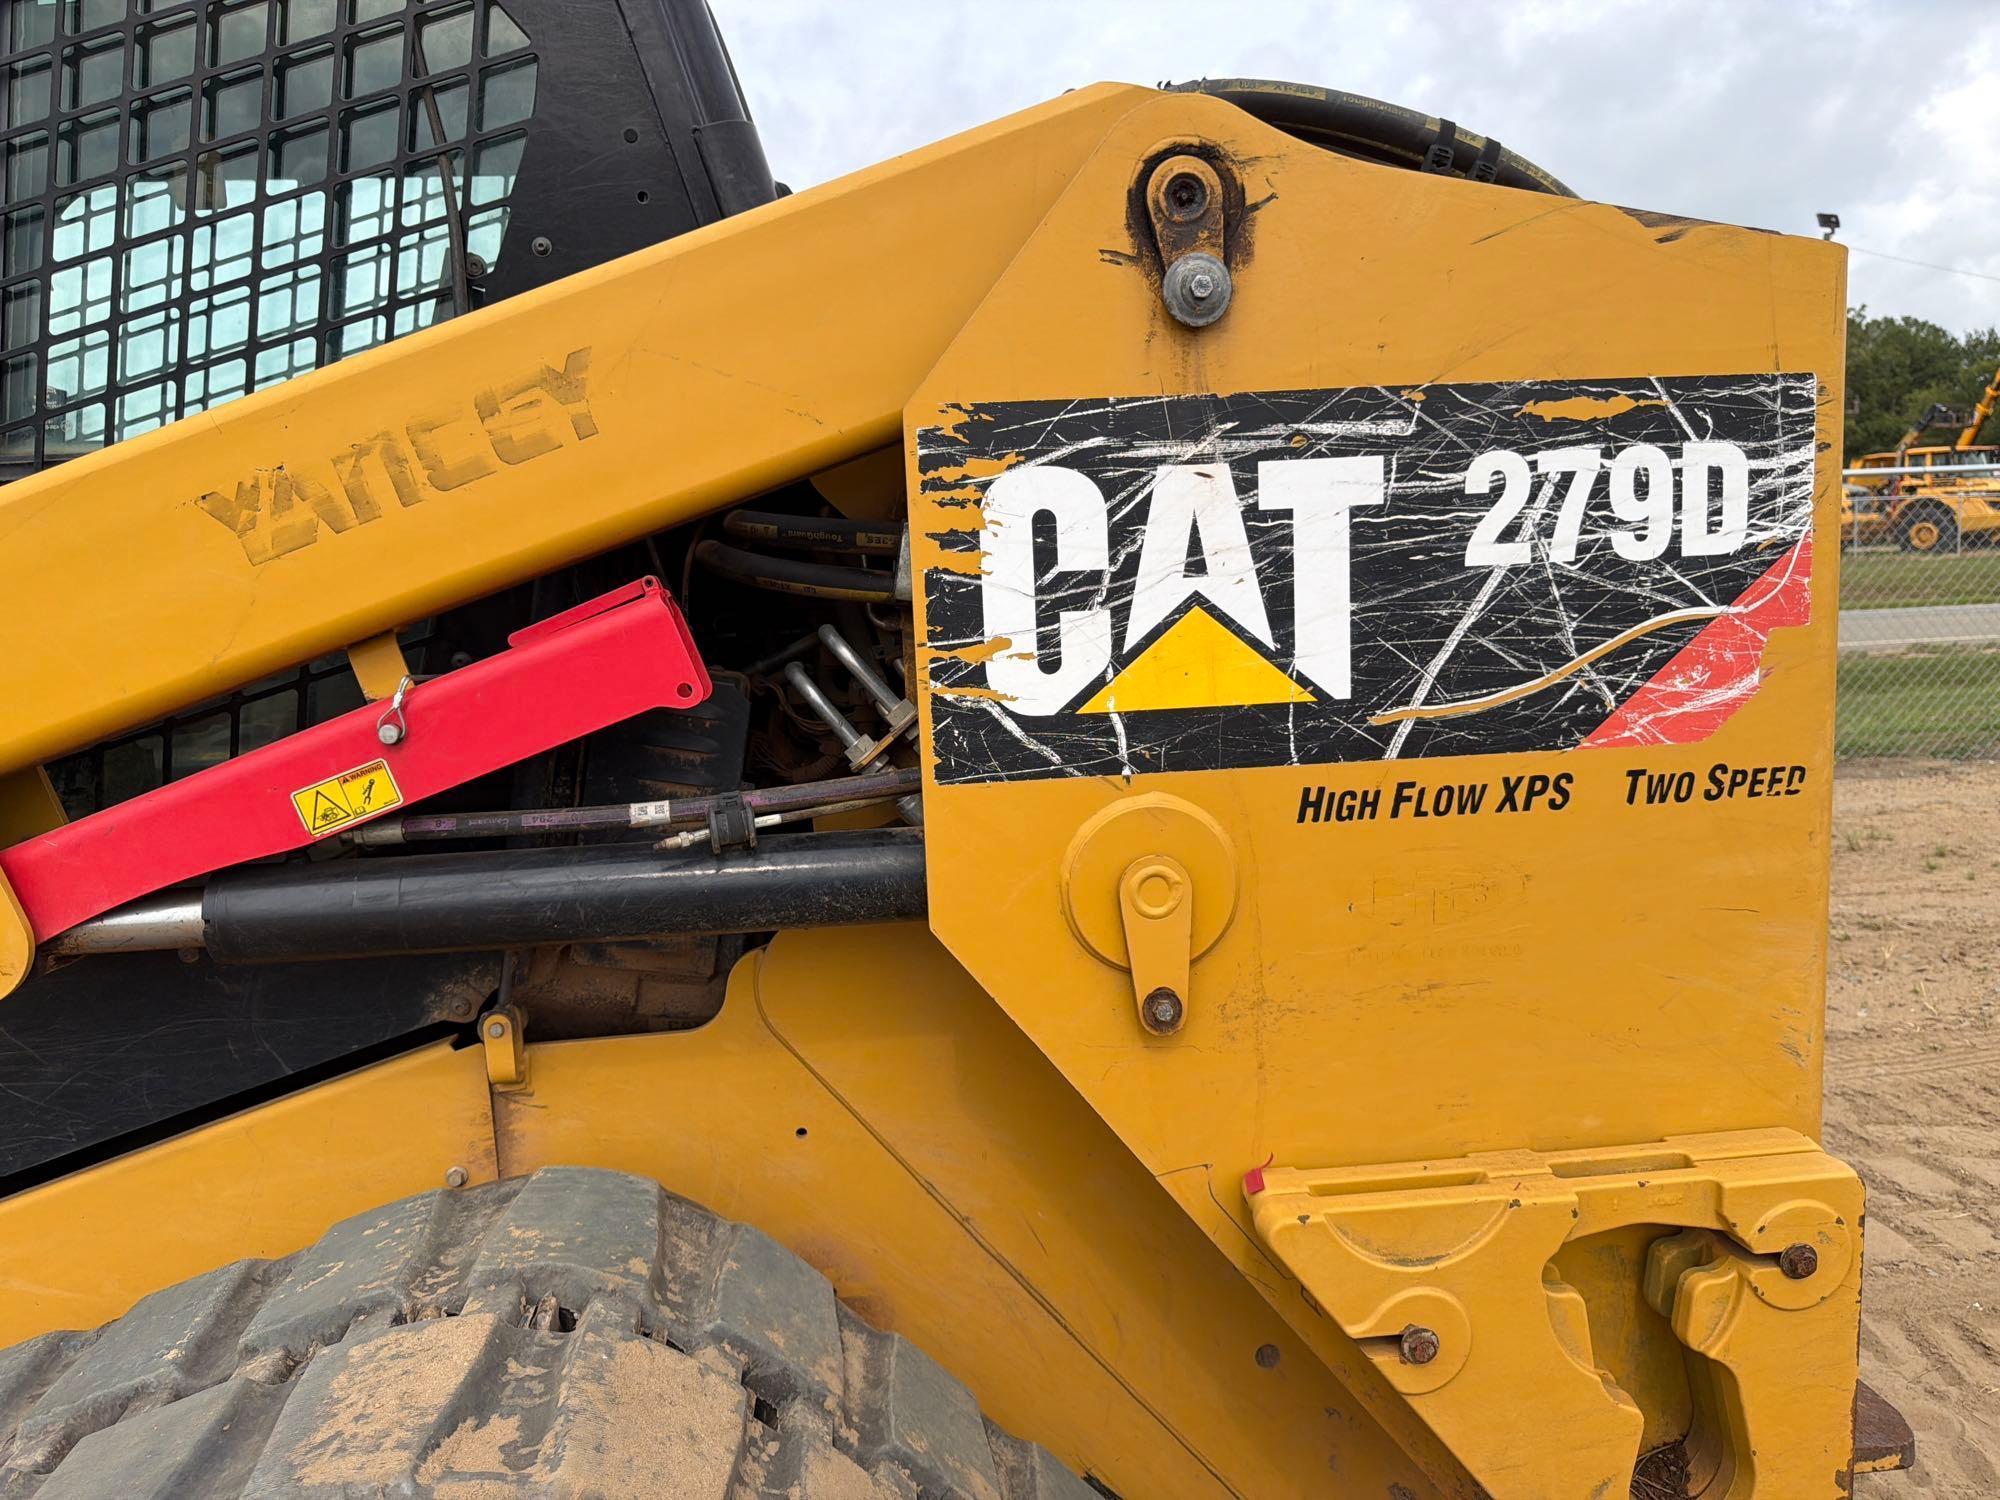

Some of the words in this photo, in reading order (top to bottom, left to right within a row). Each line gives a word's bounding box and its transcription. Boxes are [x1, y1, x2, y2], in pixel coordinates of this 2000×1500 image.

[980, 454, 1385, 717] CAT
[1464, 442, 1749, 568] 279D
[349, 764, 383, 781] WARNING
[1626, 768, 1695, 806] TWO
[1703, 763, 1806, 802] SPEED
[1296, 786, 1382, 824] HIGH
[1390, 781, 1489, 819] FLOW
[1495, 772, 1574, 813] XPS
